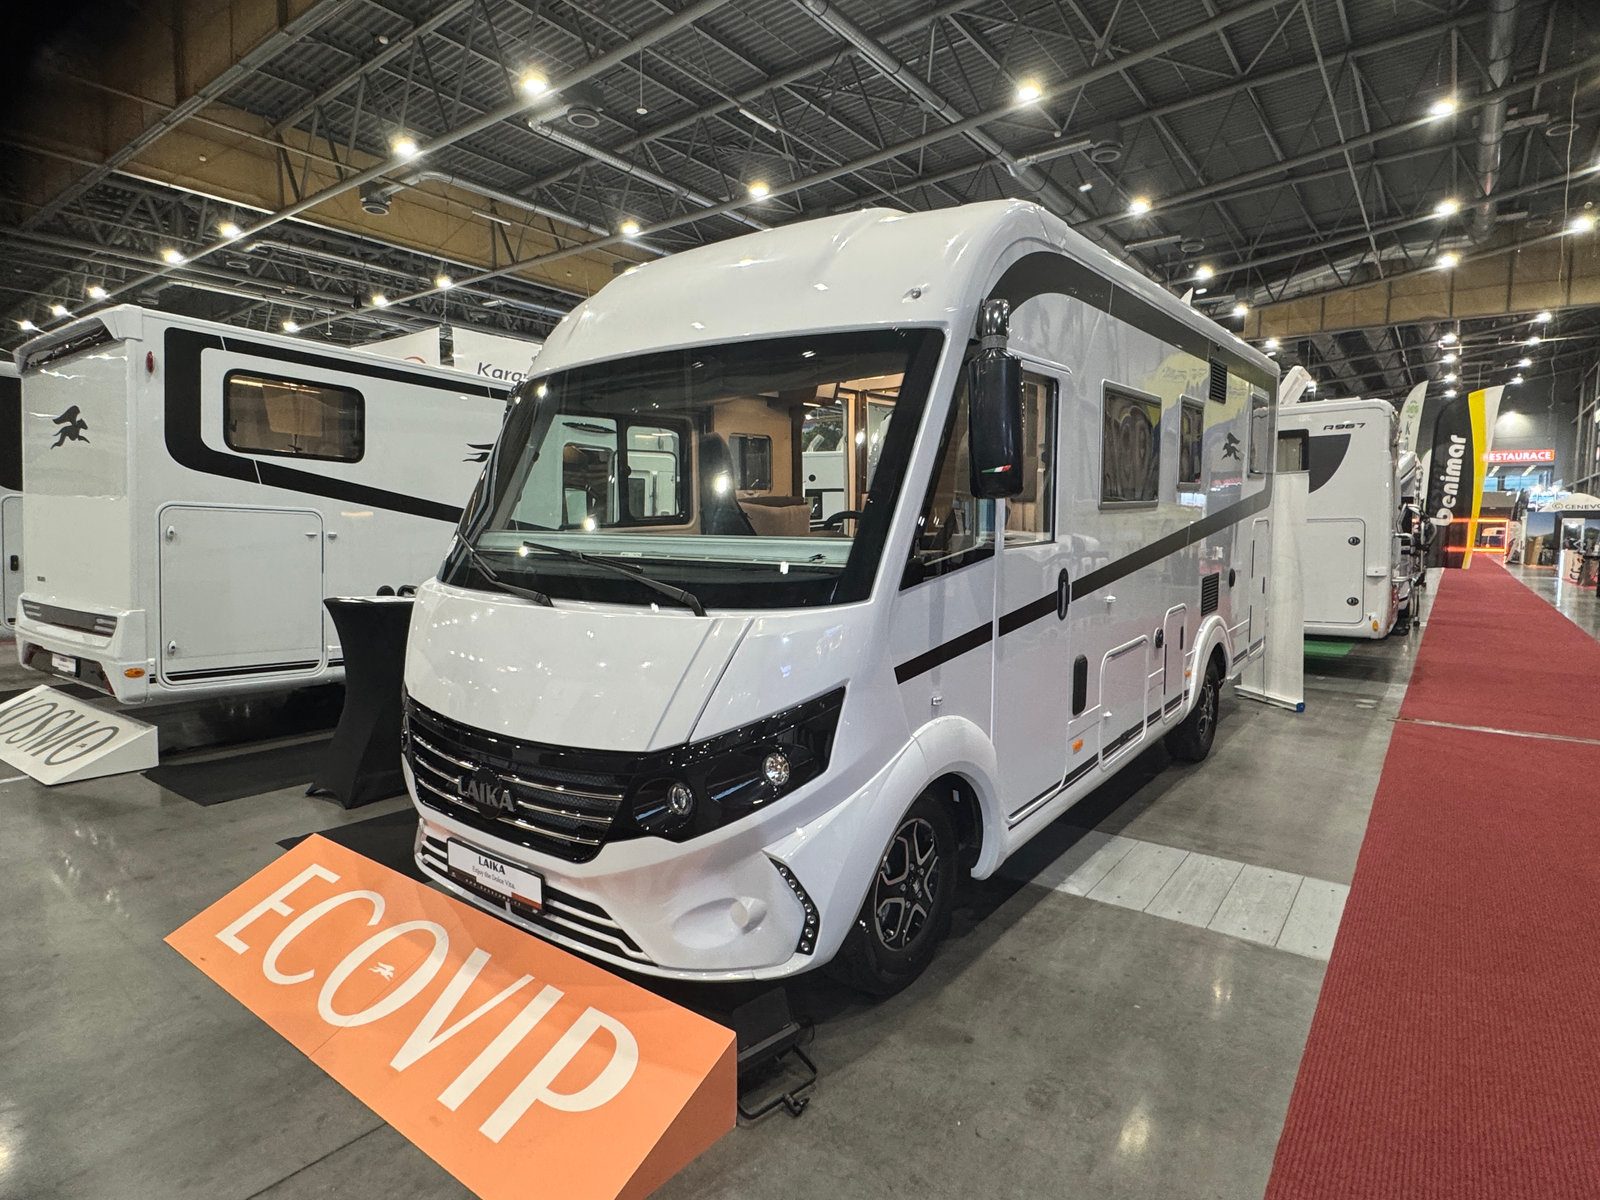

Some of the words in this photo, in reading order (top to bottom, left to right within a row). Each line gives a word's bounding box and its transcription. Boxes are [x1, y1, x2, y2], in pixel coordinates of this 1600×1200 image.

[1484, 451, 1551, 461] ESTAURACE
[1430, 434, 1467, 526] benimar
[457, 775, 515, 813] LAIKA
[478, 855, 506, 876] LAIKA
[215, 863, 639, 1144] ECOVIP
